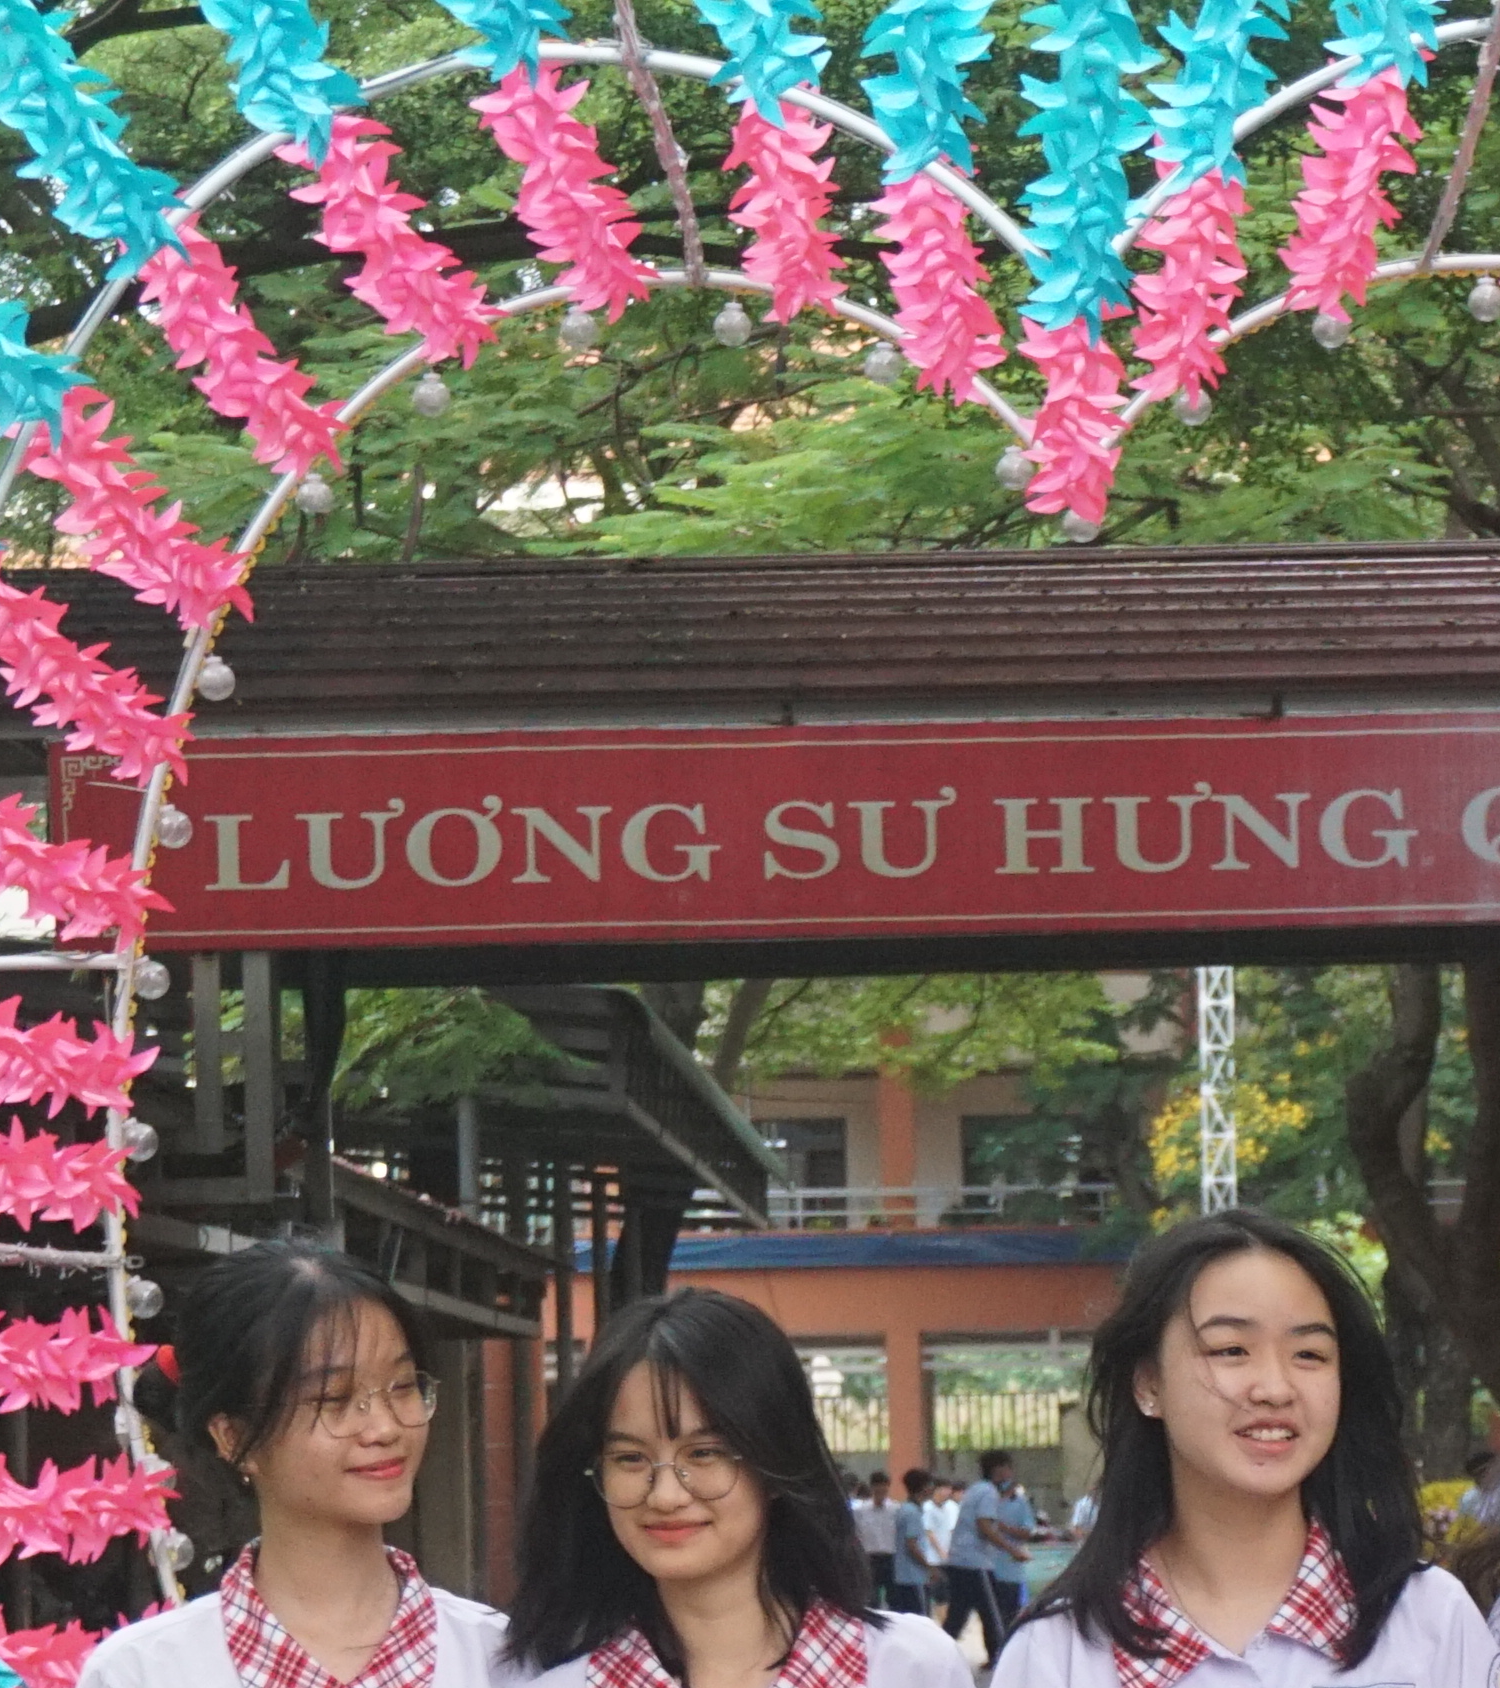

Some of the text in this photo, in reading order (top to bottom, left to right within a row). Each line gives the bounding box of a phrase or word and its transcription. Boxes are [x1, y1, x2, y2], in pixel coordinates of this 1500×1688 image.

[203, 794, 721, 892] LƯƠNG
[763, 786, 958, 881] SƯ
[992, 780, 1420, 875] HƯNG
